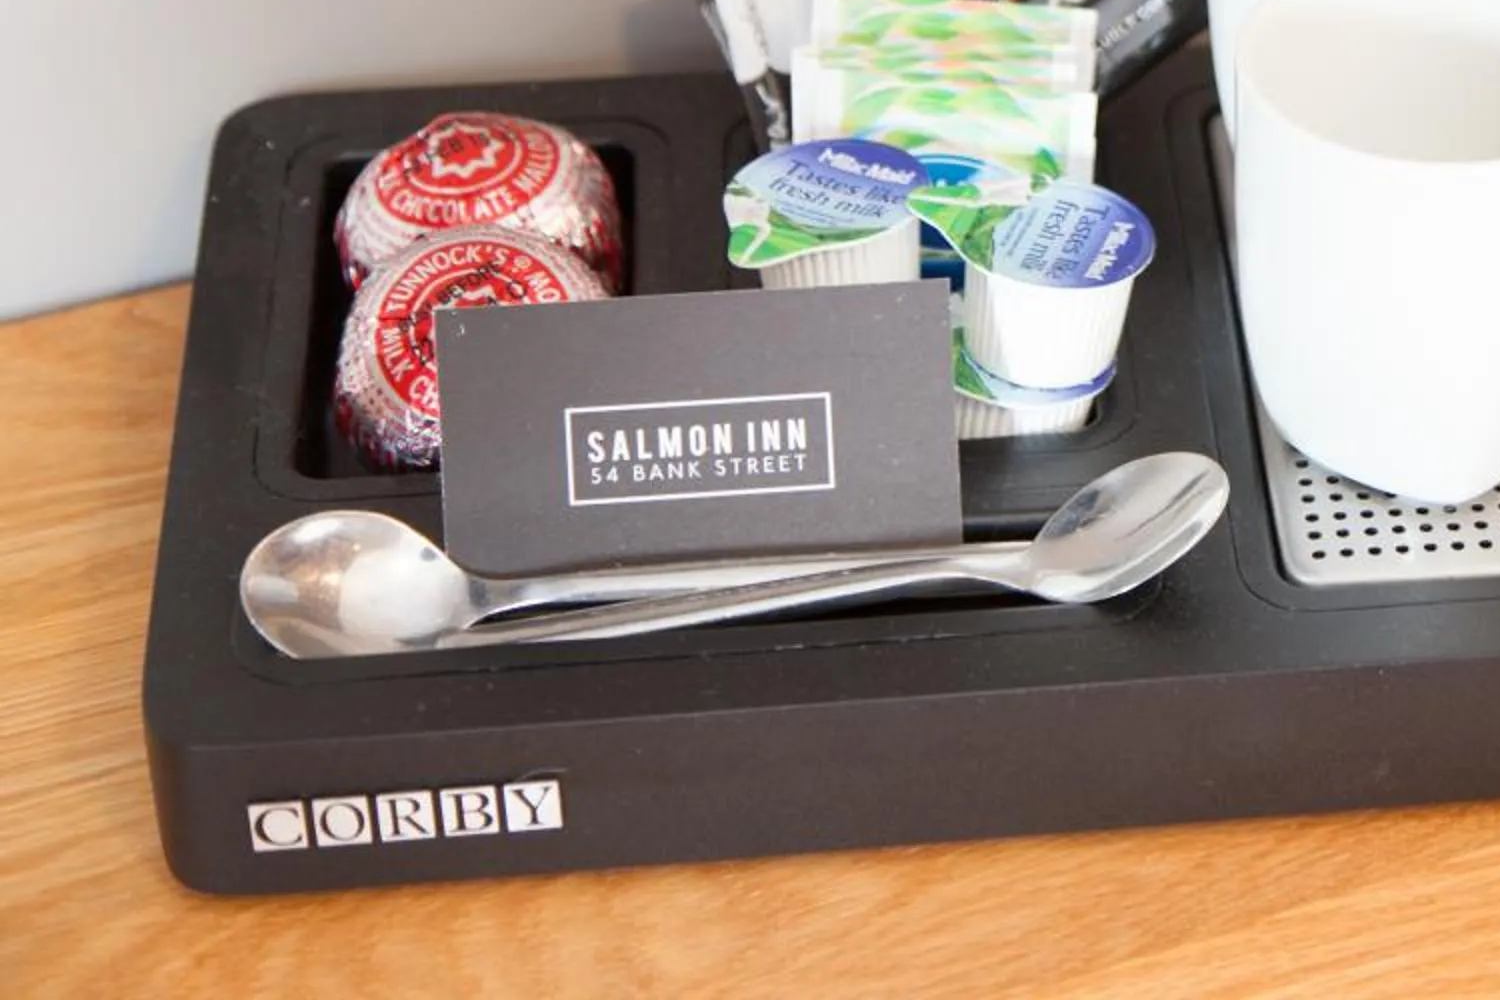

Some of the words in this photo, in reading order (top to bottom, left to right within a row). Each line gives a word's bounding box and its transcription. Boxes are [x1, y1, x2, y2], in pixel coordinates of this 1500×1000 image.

[769, 175, 831, 205] fresh
[833, 196, 887, 219] milk
[784, 159, 862, 196] Tastes
[1041, 199, 1080, 241] fresh
[1061, 204, 1111, 255] Tastes
[387, 244, 510, 311] TUNNOCK'S
[381, 327, 415, 382] MILK
[587, 422, 733, 464] SALMON
[746, 417, 807, 452] INN
[590, 465, 619, 485] 54
[632, 459, 702, 483] BANK
[714, 453, 808, 477] STREET
[251, 782, 560, 850] CORBY
